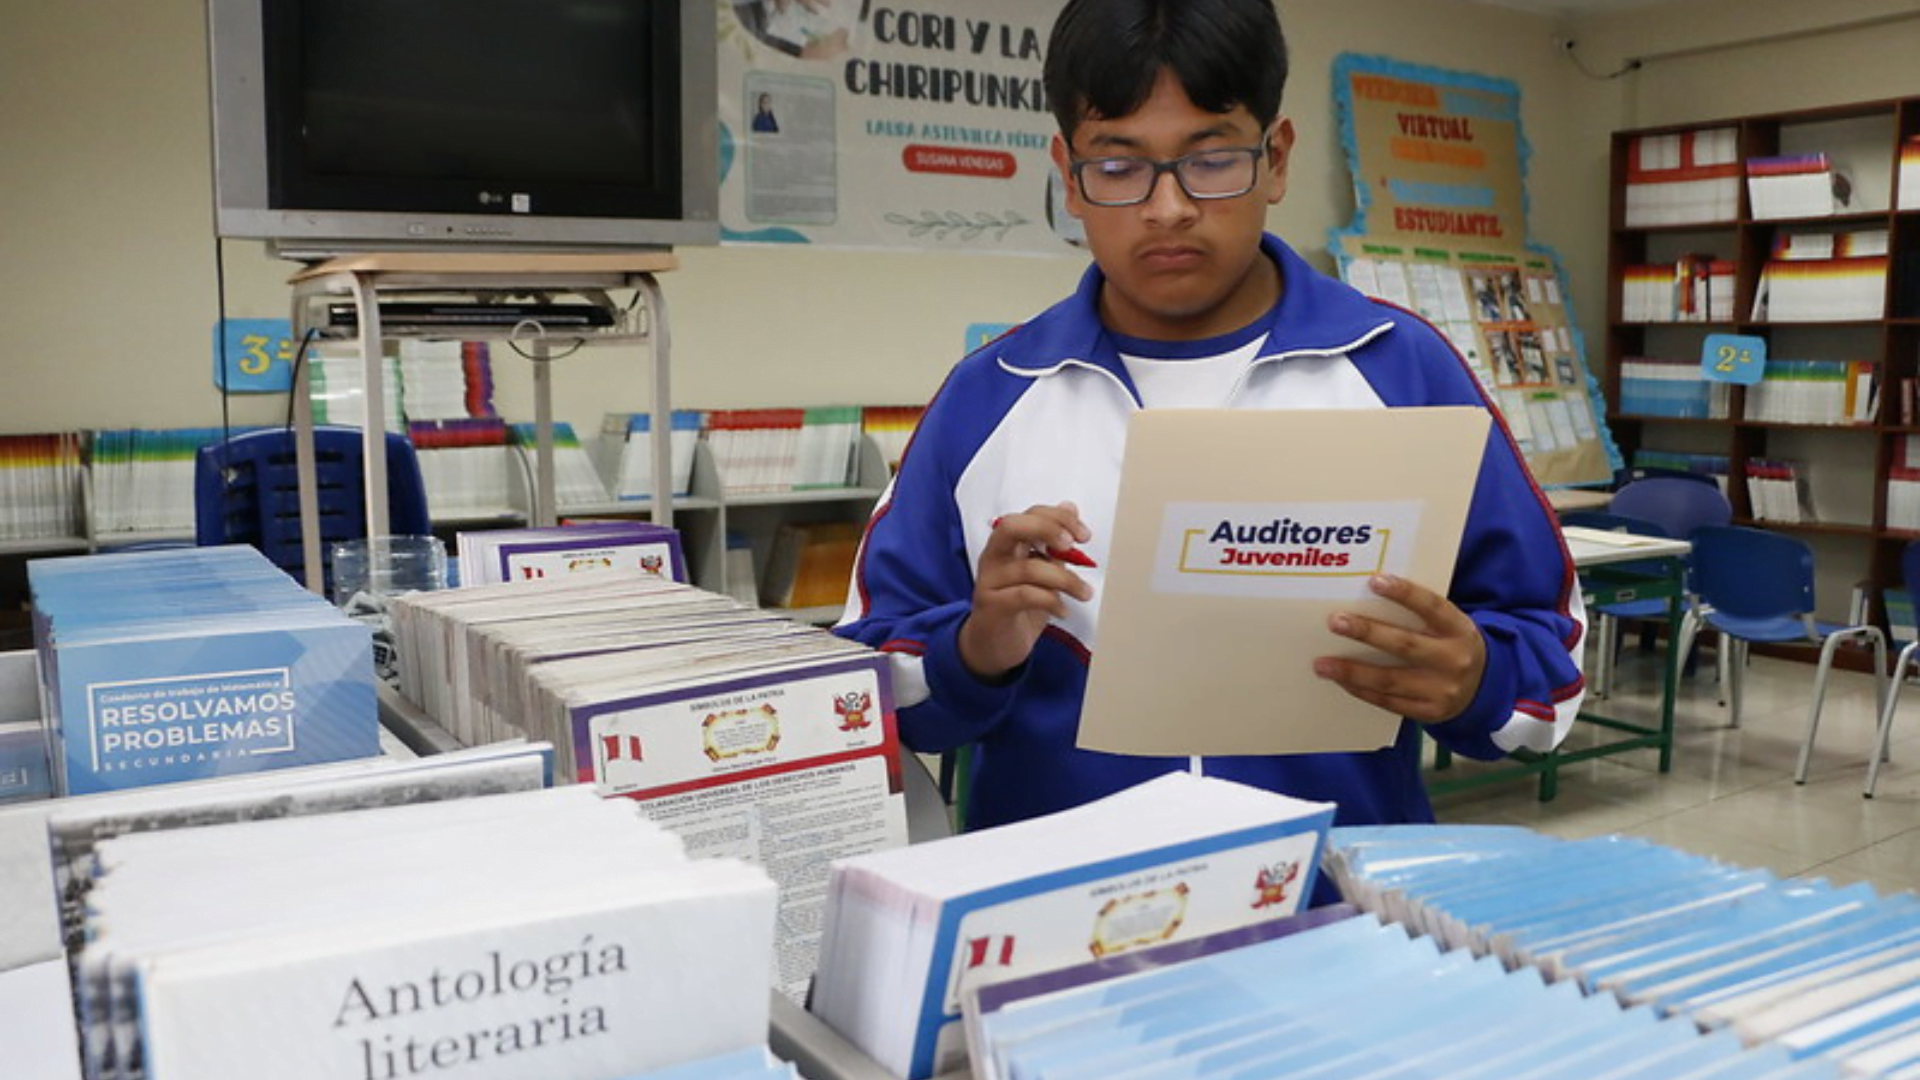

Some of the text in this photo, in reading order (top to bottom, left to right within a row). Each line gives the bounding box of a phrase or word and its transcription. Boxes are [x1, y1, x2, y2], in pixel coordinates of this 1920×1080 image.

[873, 8, 1042, 62] CORI Y LA
[844, 57, 1053, 112] CHIRIPUNKI
[1397, 112, 1473, 142] VIRTUAL
[915, 152, 958, 167] SUSANA
[1393, 206, 1503, 237] ESTUDIANTIL
[1209, 518, 1372, 545] Auditores
[1220, 547, 1350, 567] Juveniles
[102, 691, 296, 728] RESOLVAMOS
[103, 717, 282, 753] PROBLEMAS
[104, 748, 247, 772] SECUNDARIA
[332, 934, 628, 1028] Antología
[360, 998, 609, 1080] literaria
